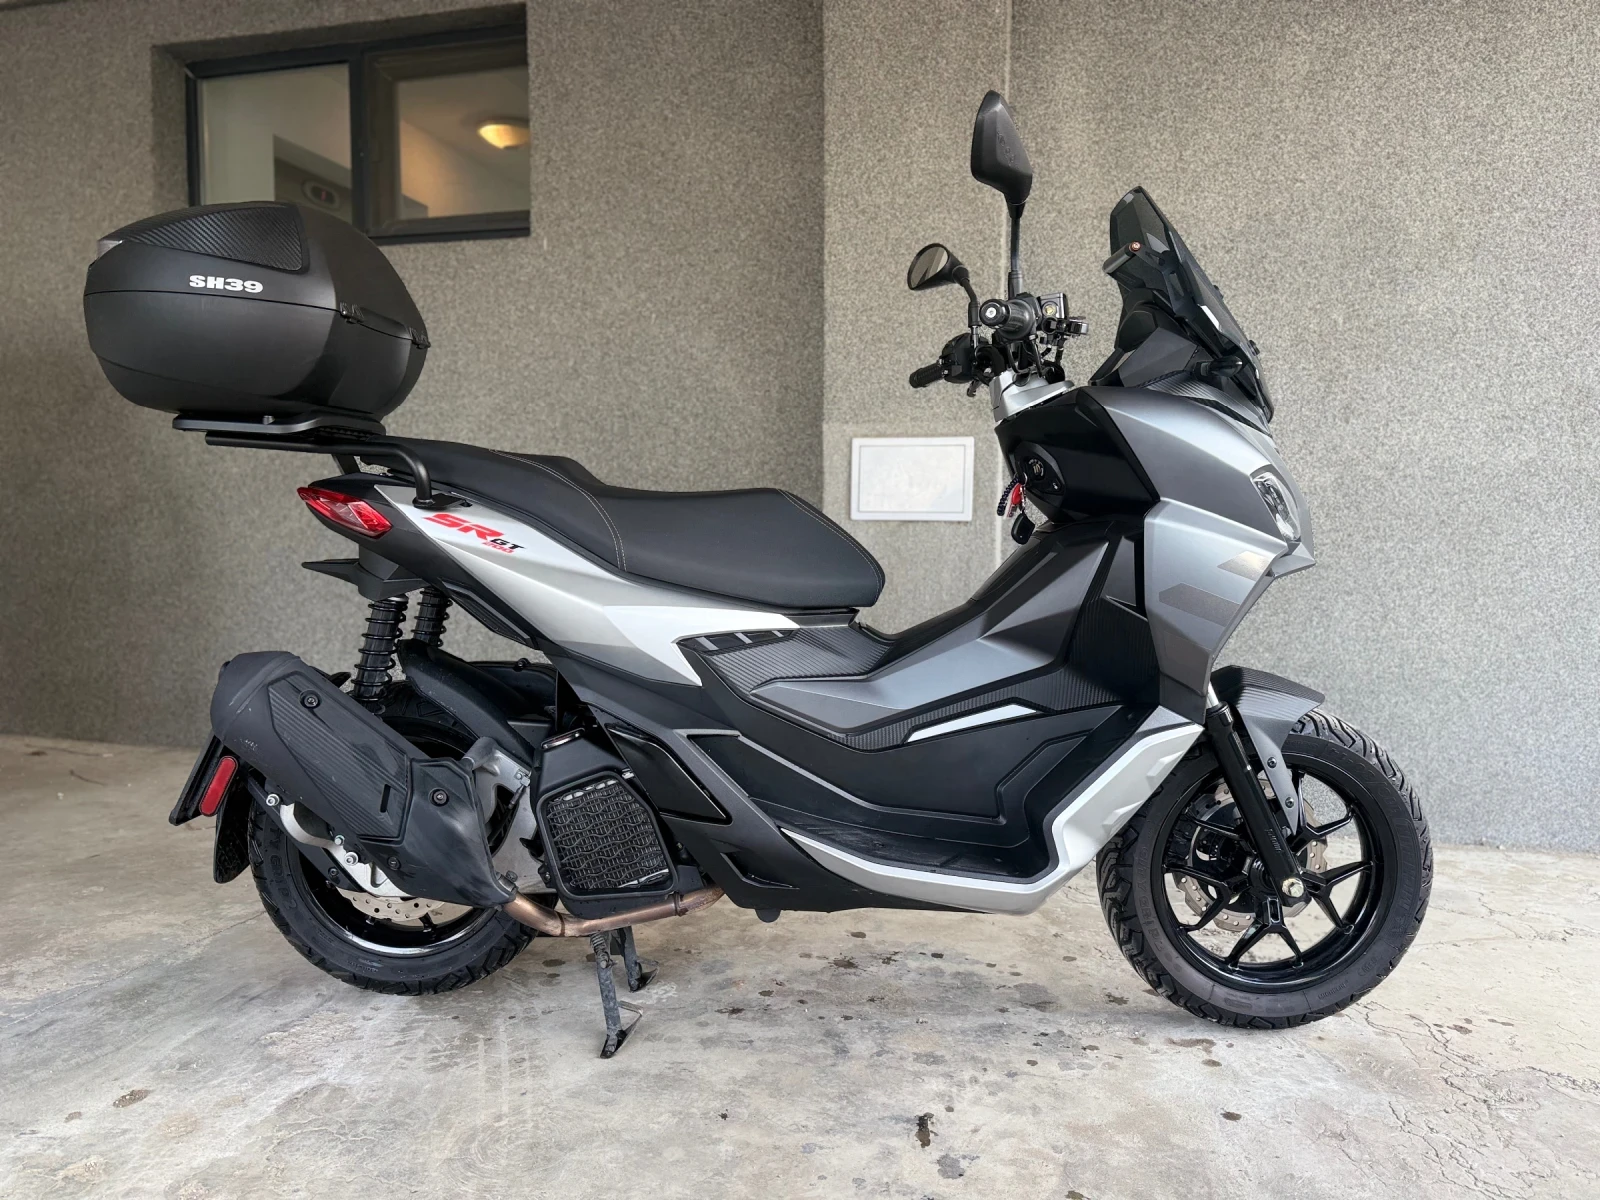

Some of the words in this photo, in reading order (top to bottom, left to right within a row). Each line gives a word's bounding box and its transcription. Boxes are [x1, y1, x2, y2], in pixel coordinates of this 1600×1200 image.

[189, 275, 263, 293] SH39
[423, 512, 504, 540] SR
[490, 538, 525, 550] GT
